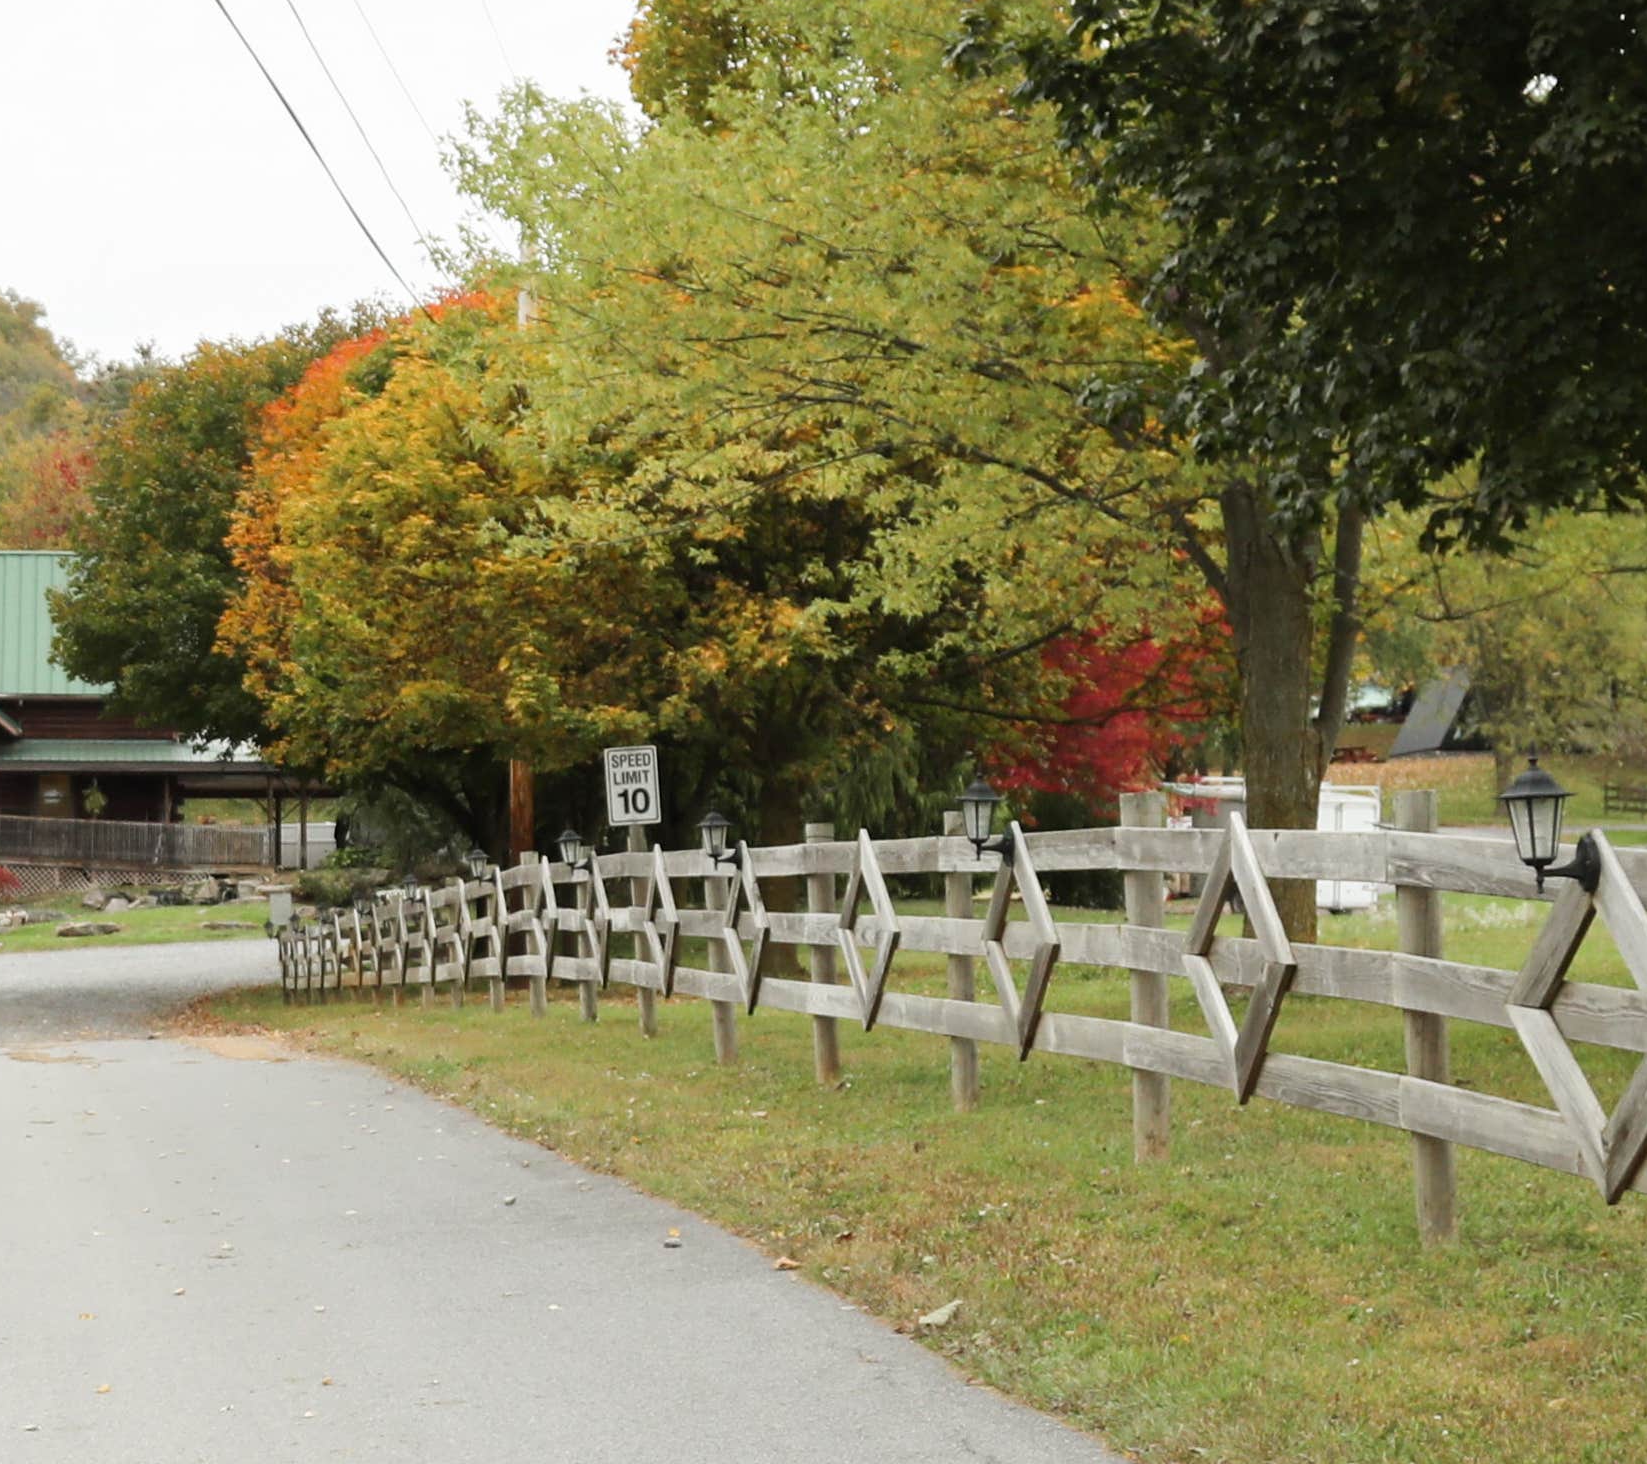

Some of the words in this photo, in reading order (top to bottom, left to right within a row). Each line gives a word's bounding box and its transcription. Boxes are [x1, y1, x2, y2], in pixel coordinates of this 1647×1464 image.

[611, 753, 651, 768] SPEED
[613, 770, 650, 785] LIMIT
[617, 788, 650, 814] 10
